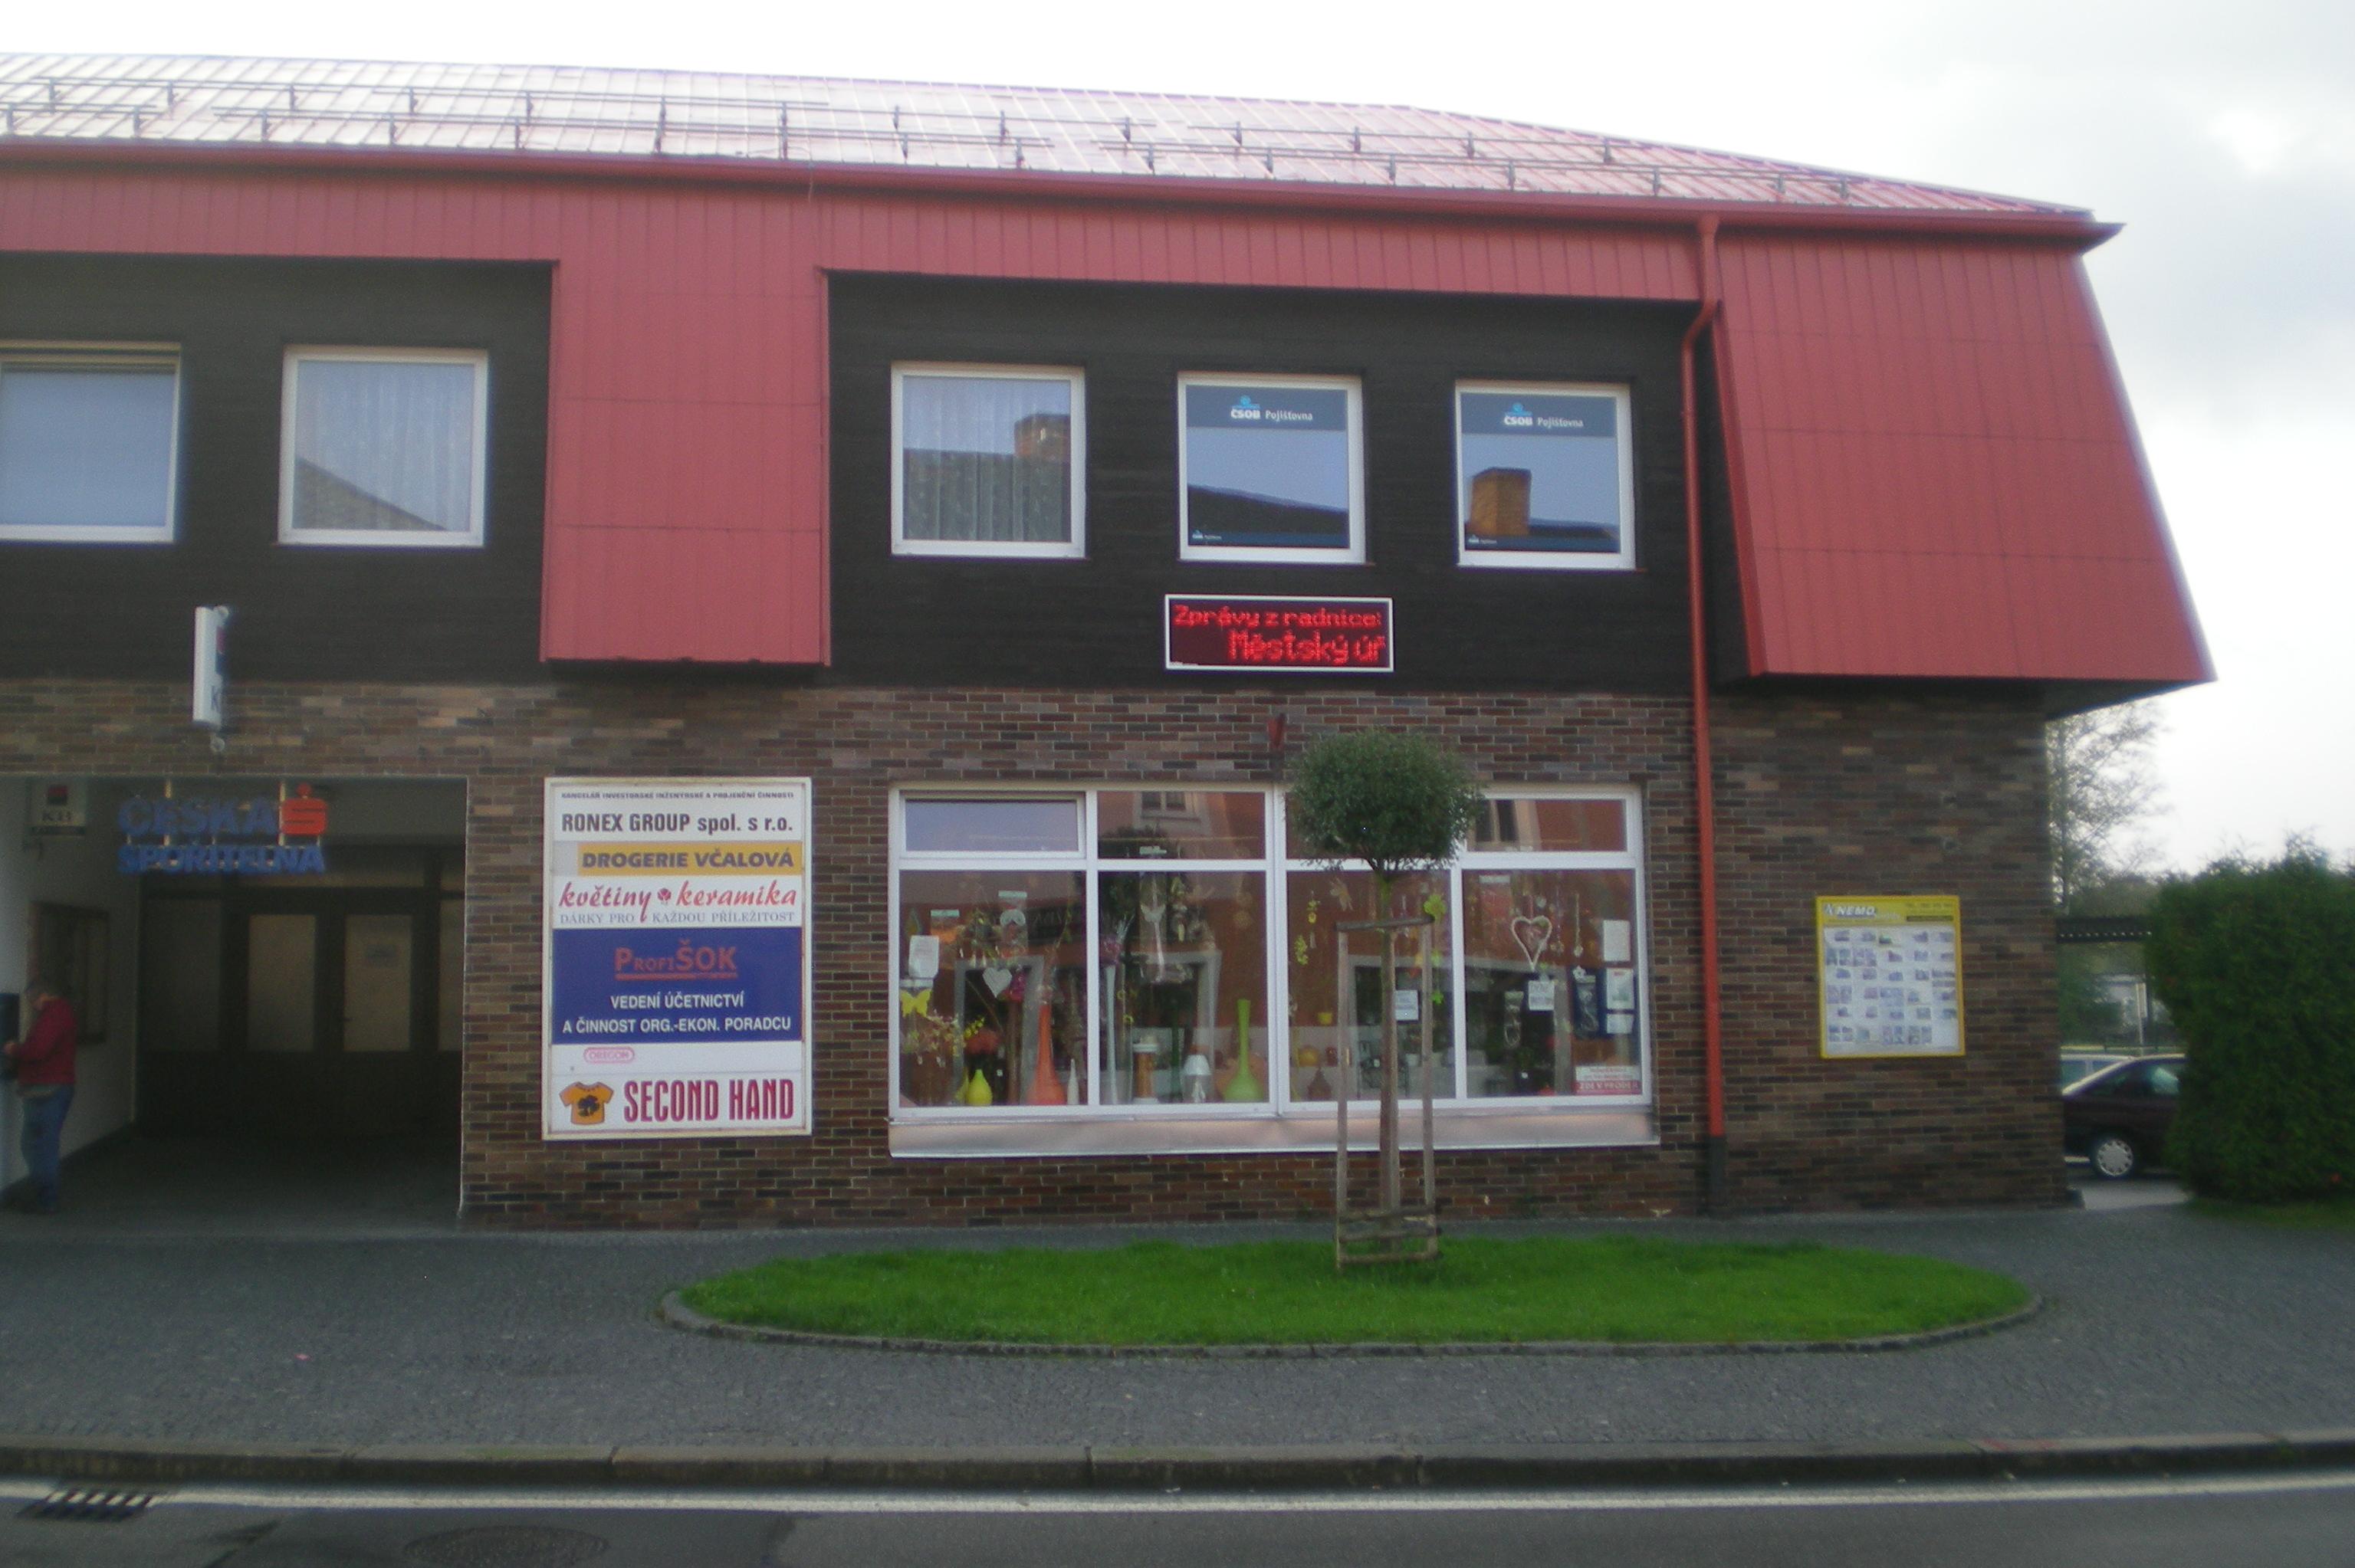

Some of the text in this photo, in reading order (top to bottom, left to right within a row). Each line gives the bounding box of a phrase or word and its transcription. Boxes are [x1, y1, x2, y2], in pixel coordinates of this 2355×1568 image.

[1230, 407, 1260, 419] ČSOB
[1174, 604, 1260, 628] Zprávy
[1265, 612, 1279, 626] z
[1228, 629, 1348, 666] Městský
[561, 813, 793, 835] RONEX GROUP spol. s r.o.
[582, 847, 793, 868] DROGERIE VČALOVÁ
[559, 880, 796, 923] květiny keramika
[560, 910, 795, 924] DÁRKY PRO KAŽDOU PŘÍLEŽITOST
[610, 990, 744, 1009] VEDENÍ ÚČETNICTVÍ
[563, 1021, 573, 1033] A
[576, 1016, 635, 1033] ČINNOST
[640, 1018, 720, 1032] ORG.-EKON.
[623, 1078, 794, 1124] SECOND HAND
